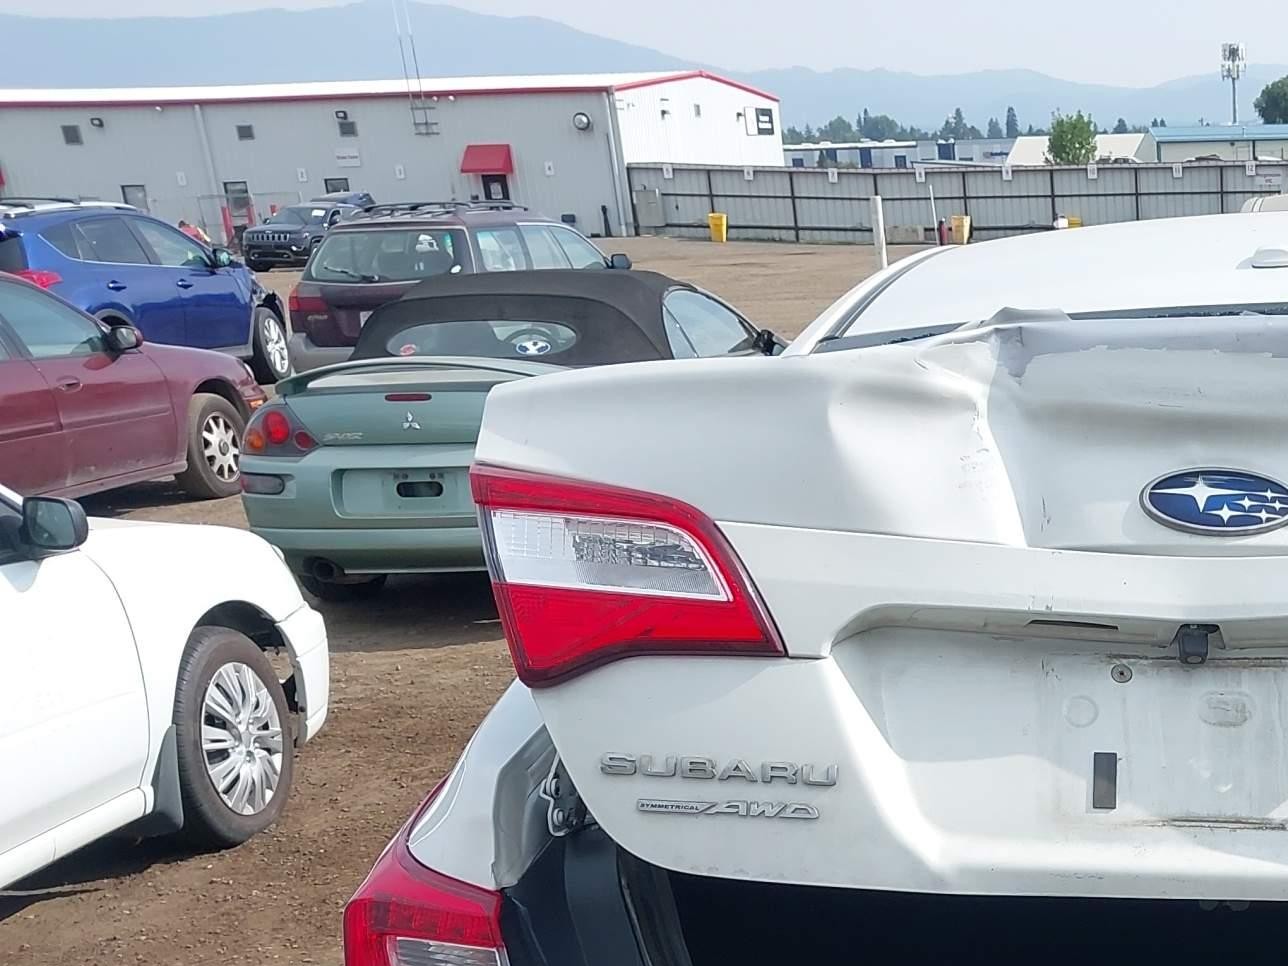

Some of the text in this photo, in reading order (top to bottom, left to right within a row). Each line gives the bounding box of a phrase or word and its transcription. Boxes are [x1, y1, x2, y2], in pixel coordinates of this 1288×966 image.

[600, 752, 838, 786] SUBARU
[640, 800, 819, 819] SYMMETRICAL AWD
